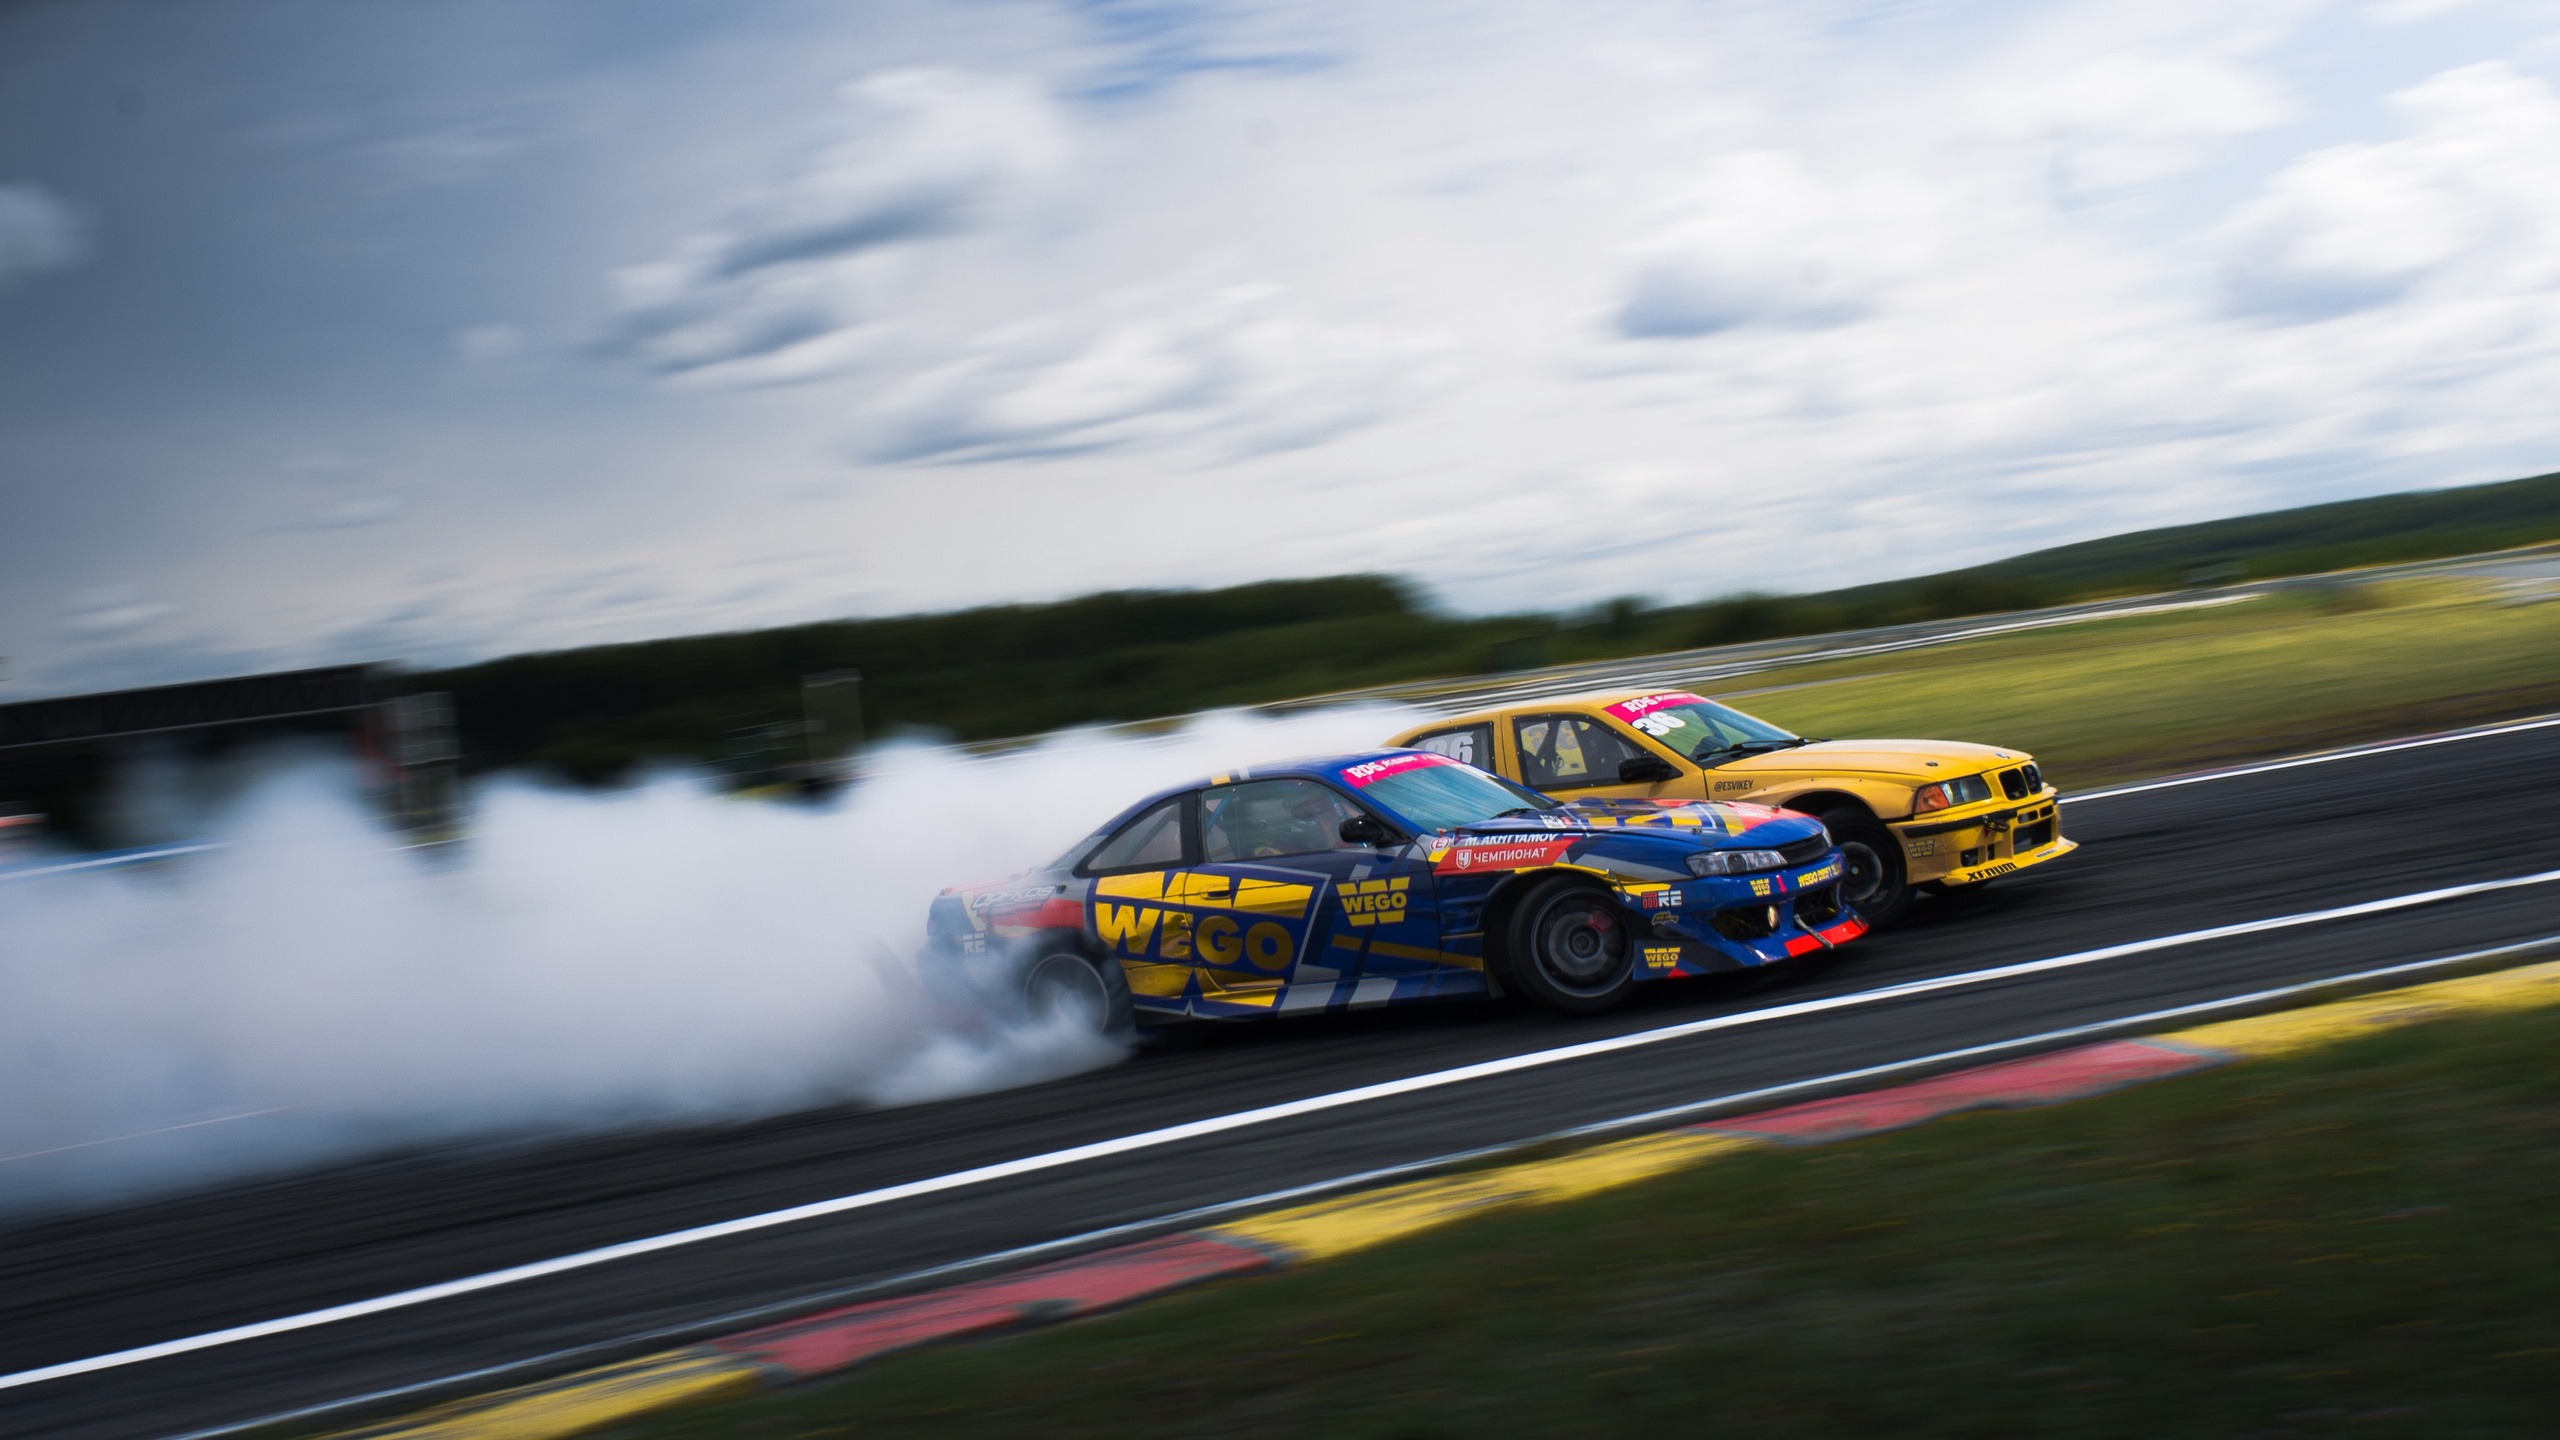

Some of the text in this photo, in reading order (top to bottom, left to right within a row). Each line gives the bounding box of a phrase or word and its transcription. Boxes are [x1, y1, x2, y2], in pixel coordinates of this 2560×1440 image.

[1621, 696, 1660, 713] RDS
[1631, 711, 1686, 736] 36
[1346, 761, 1386, 779] RDS
[1714, 780, 1754, 792] @ESVIKEY
[1474, 847, 1548, 863] ЧЕМПИОНАТ
[1910, 844, 1934, 854] WEGO
[1797, 871, 1819, 888] WEGO
[1341, 891, 1407, 913] WEGO
[1094, 900, 1294, 972] WEGO
[1645, 952, 1679, 962] WEGO
